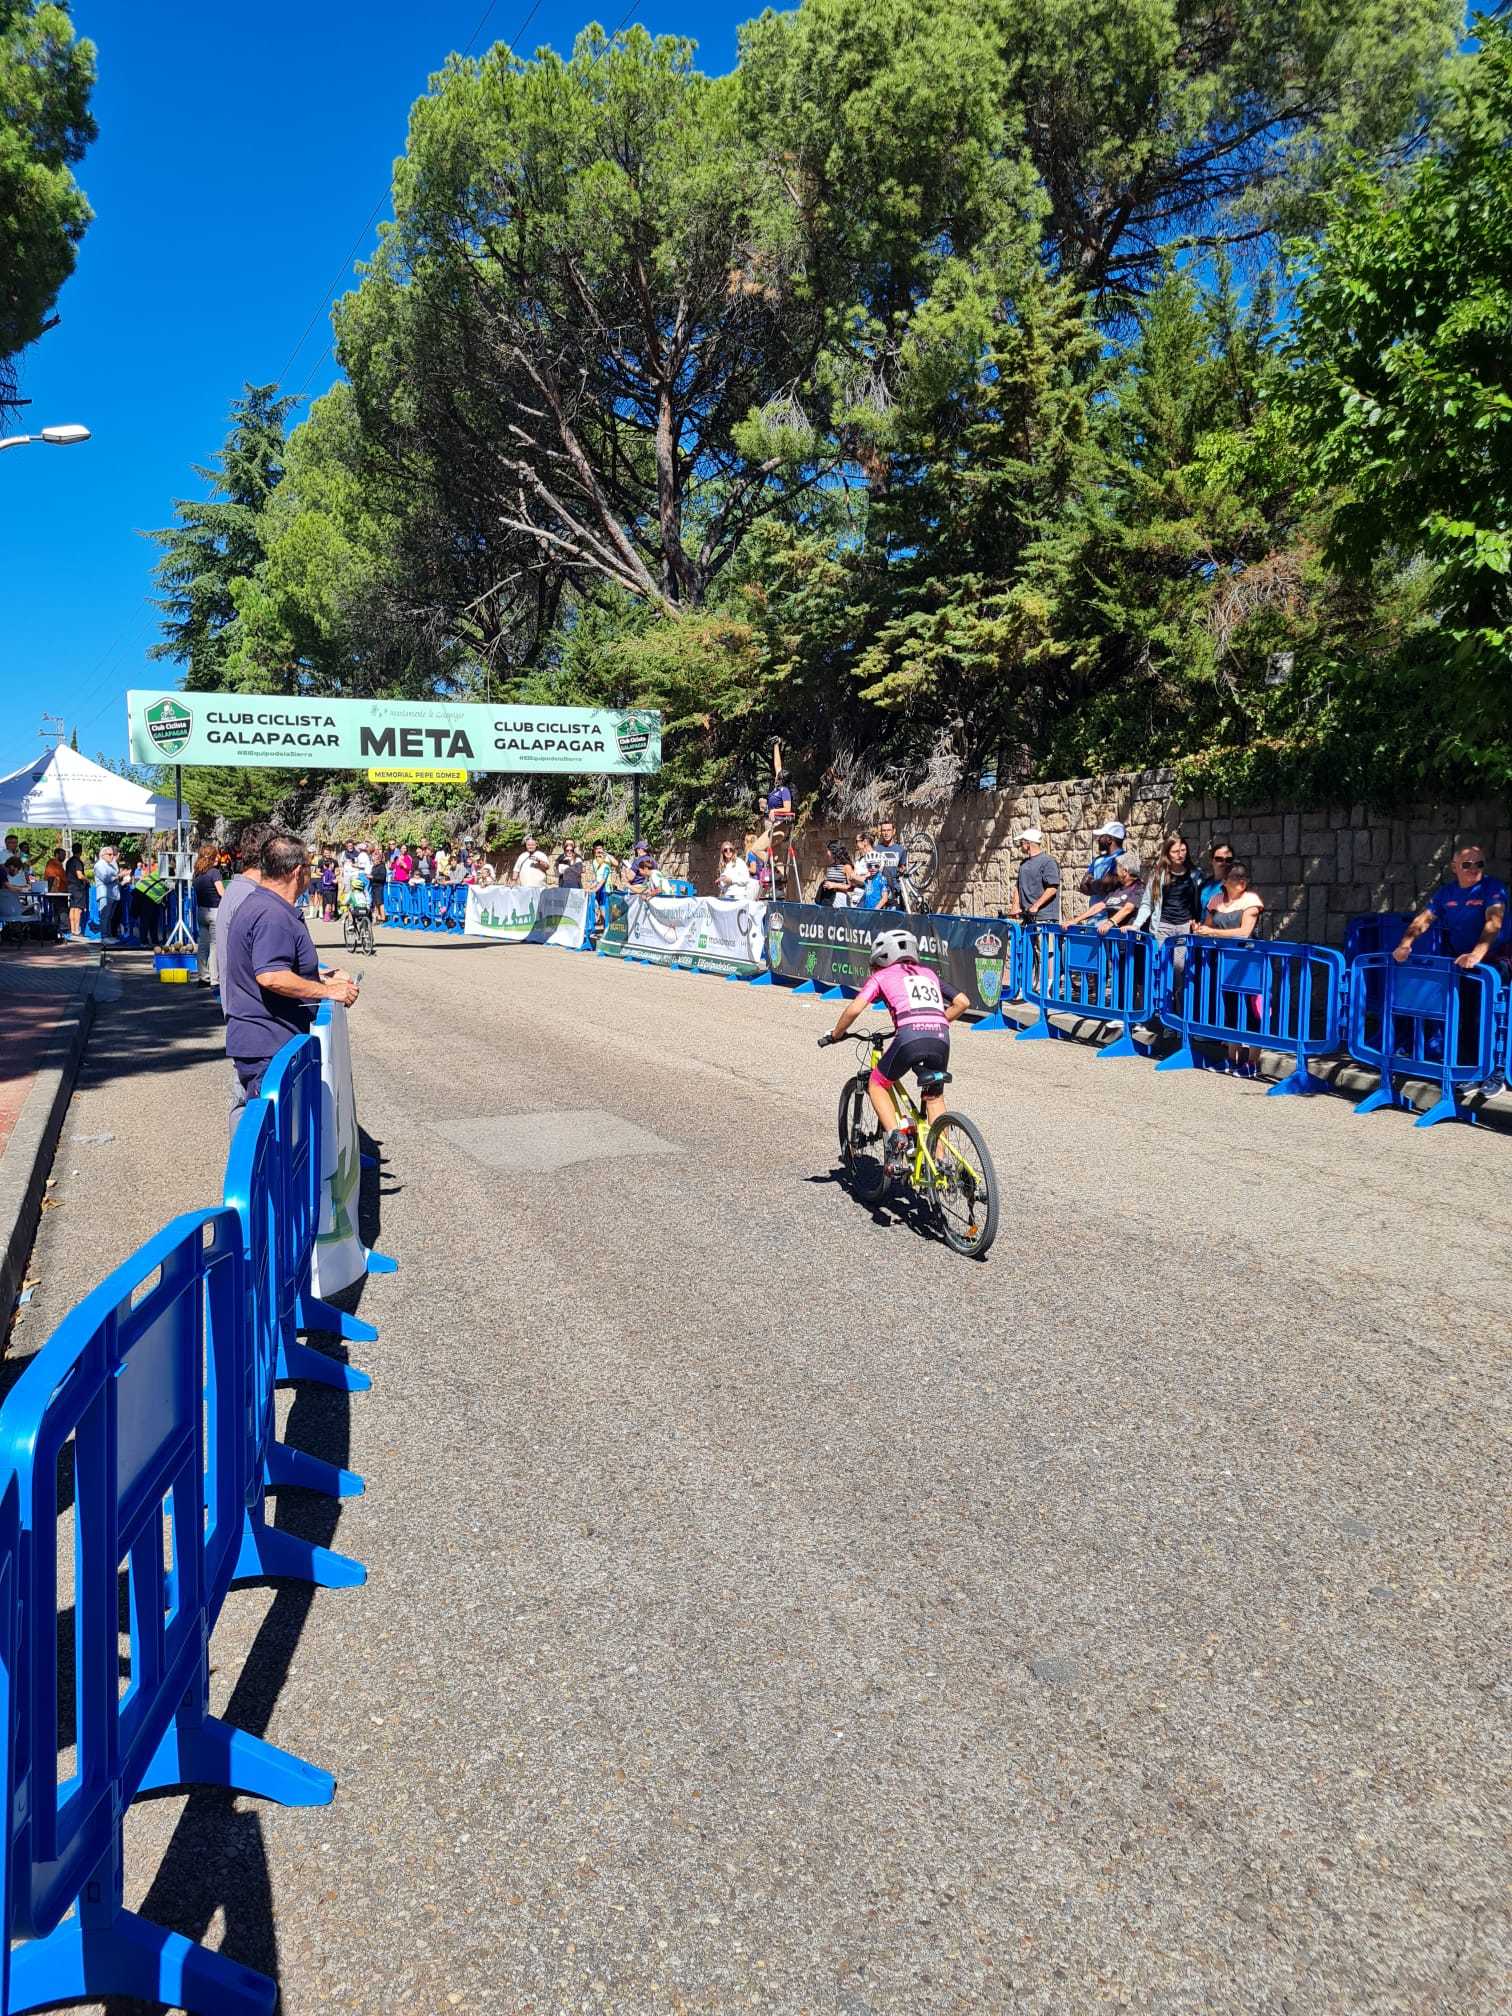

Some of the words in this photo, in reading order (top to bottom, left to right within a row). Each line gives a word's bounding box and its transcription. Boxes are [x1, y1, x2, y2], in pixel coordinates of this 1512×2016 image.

[206, 712, 254, 725] CLUB
[257, 714, 336, 727] CICLISTA
[152, 728, 188, 739] GALAPAGAR
[494, 721, 534, 732] CLUB
[537, 722, 602, 735] CICLISTA
[206, 731, 340, 747] GALAPAGAR
[360, 726, 475, 758] META
[494, 738, 605, 752] GALAPAGAR
[799, 923, 824, 939] CLUB
[827, 926, 872, 946] CICLISTA
[911, 985, 939, 1003] 439
